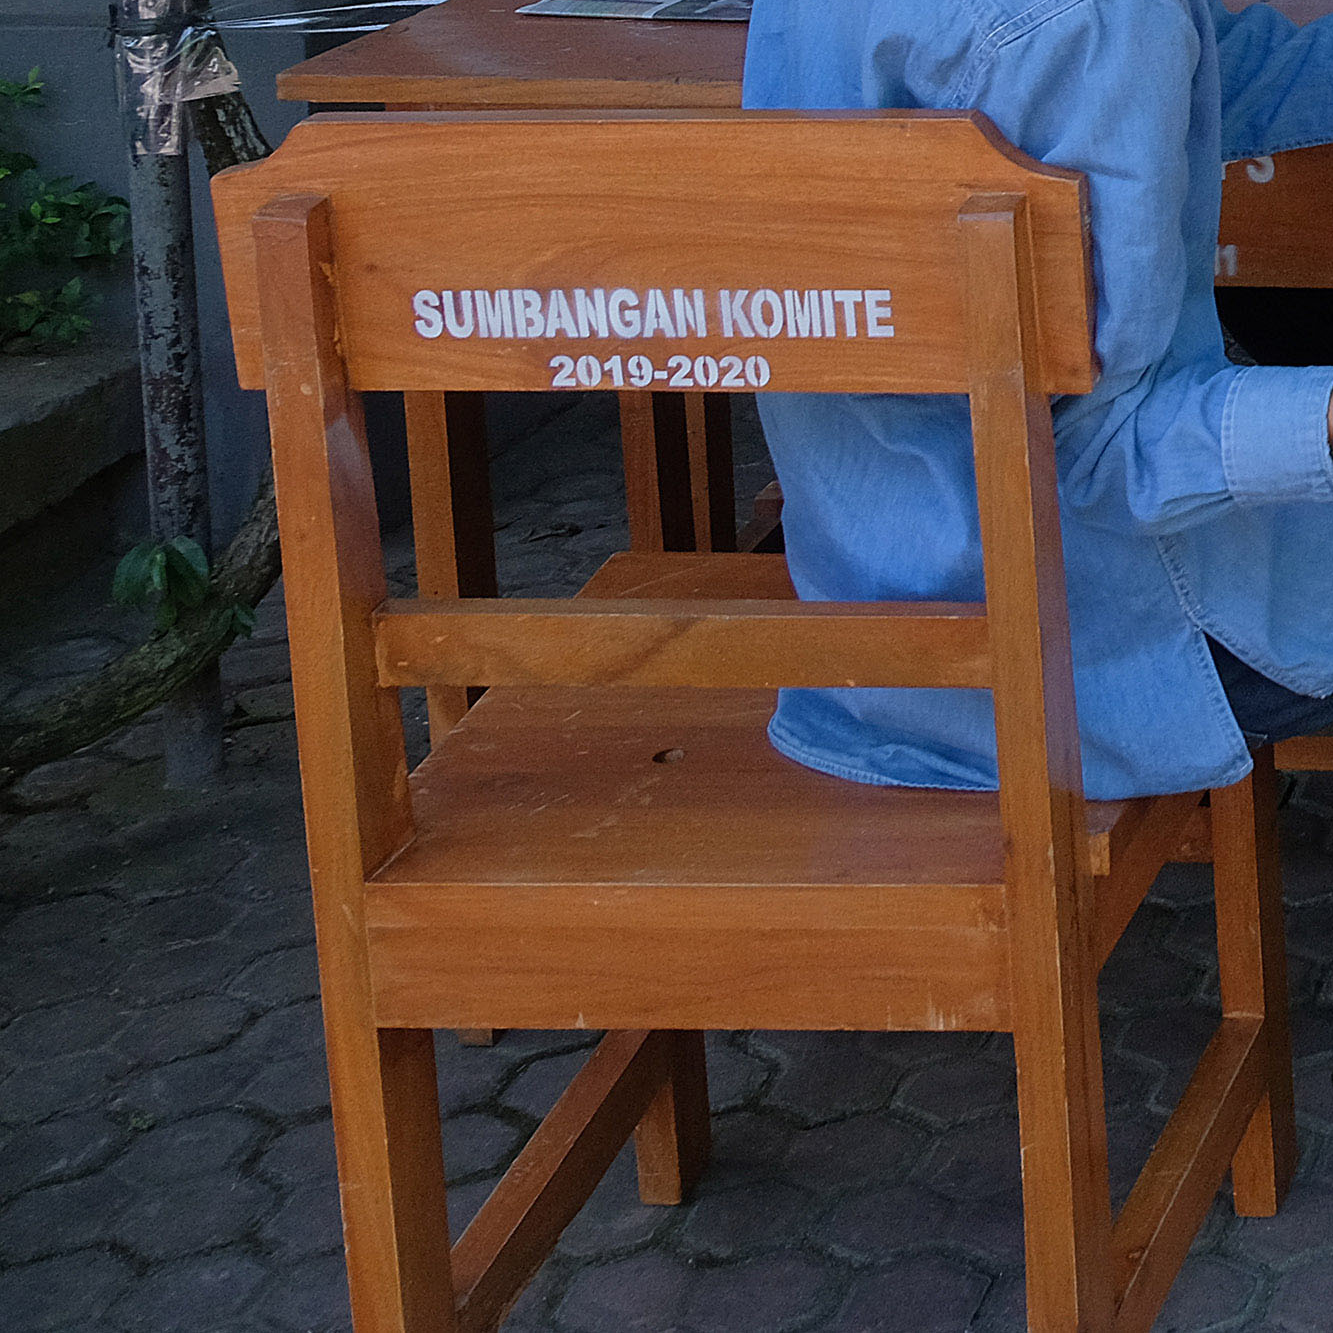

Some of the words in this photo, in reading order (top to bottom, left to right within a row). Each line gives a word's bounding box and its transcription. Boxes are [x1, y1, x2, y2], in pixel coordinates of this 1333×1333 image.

[412, 287, 708, 339] SUMBANGAN
[717, 289, 895, 339] KOMITE
[549, 355, 771, 388] 2019-2020
